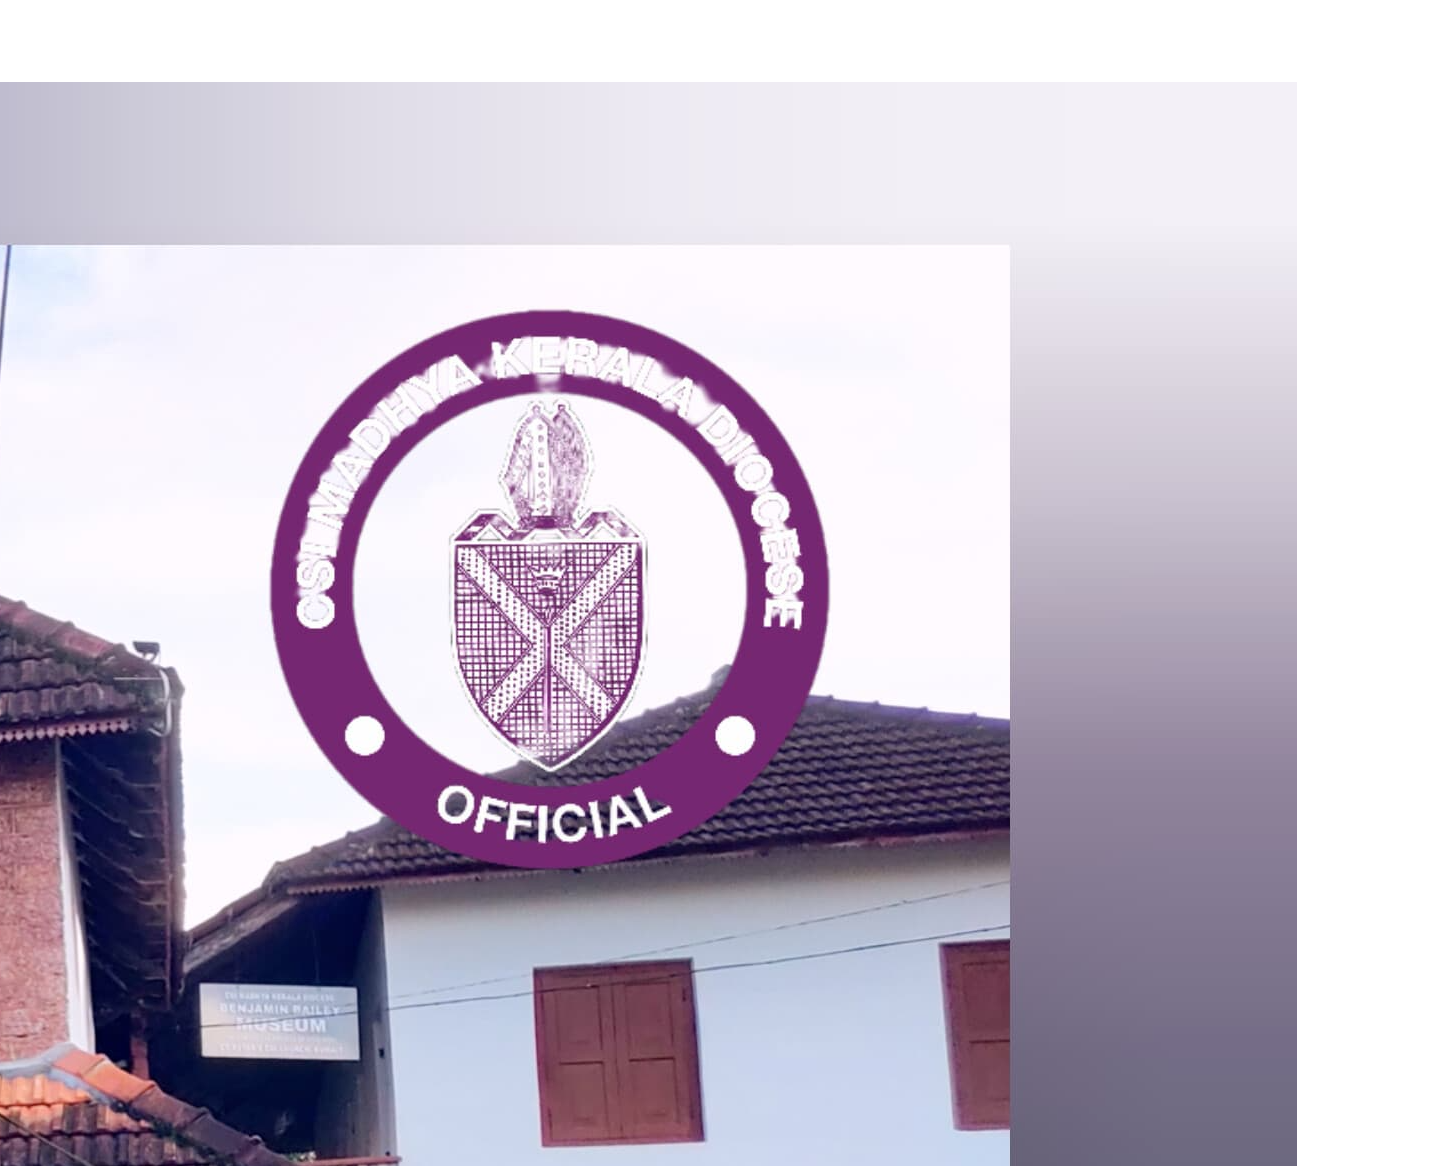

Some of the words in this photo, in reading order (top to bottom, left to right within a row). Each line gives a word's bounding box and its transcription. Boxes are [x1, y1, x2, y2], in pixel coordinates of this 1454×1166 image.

[219, 1002, 288, 1015] BENJAMIN
[292, 1003, 341, 1016] BAILEY
[235, 1017, 328, 1034] MUSEUM
